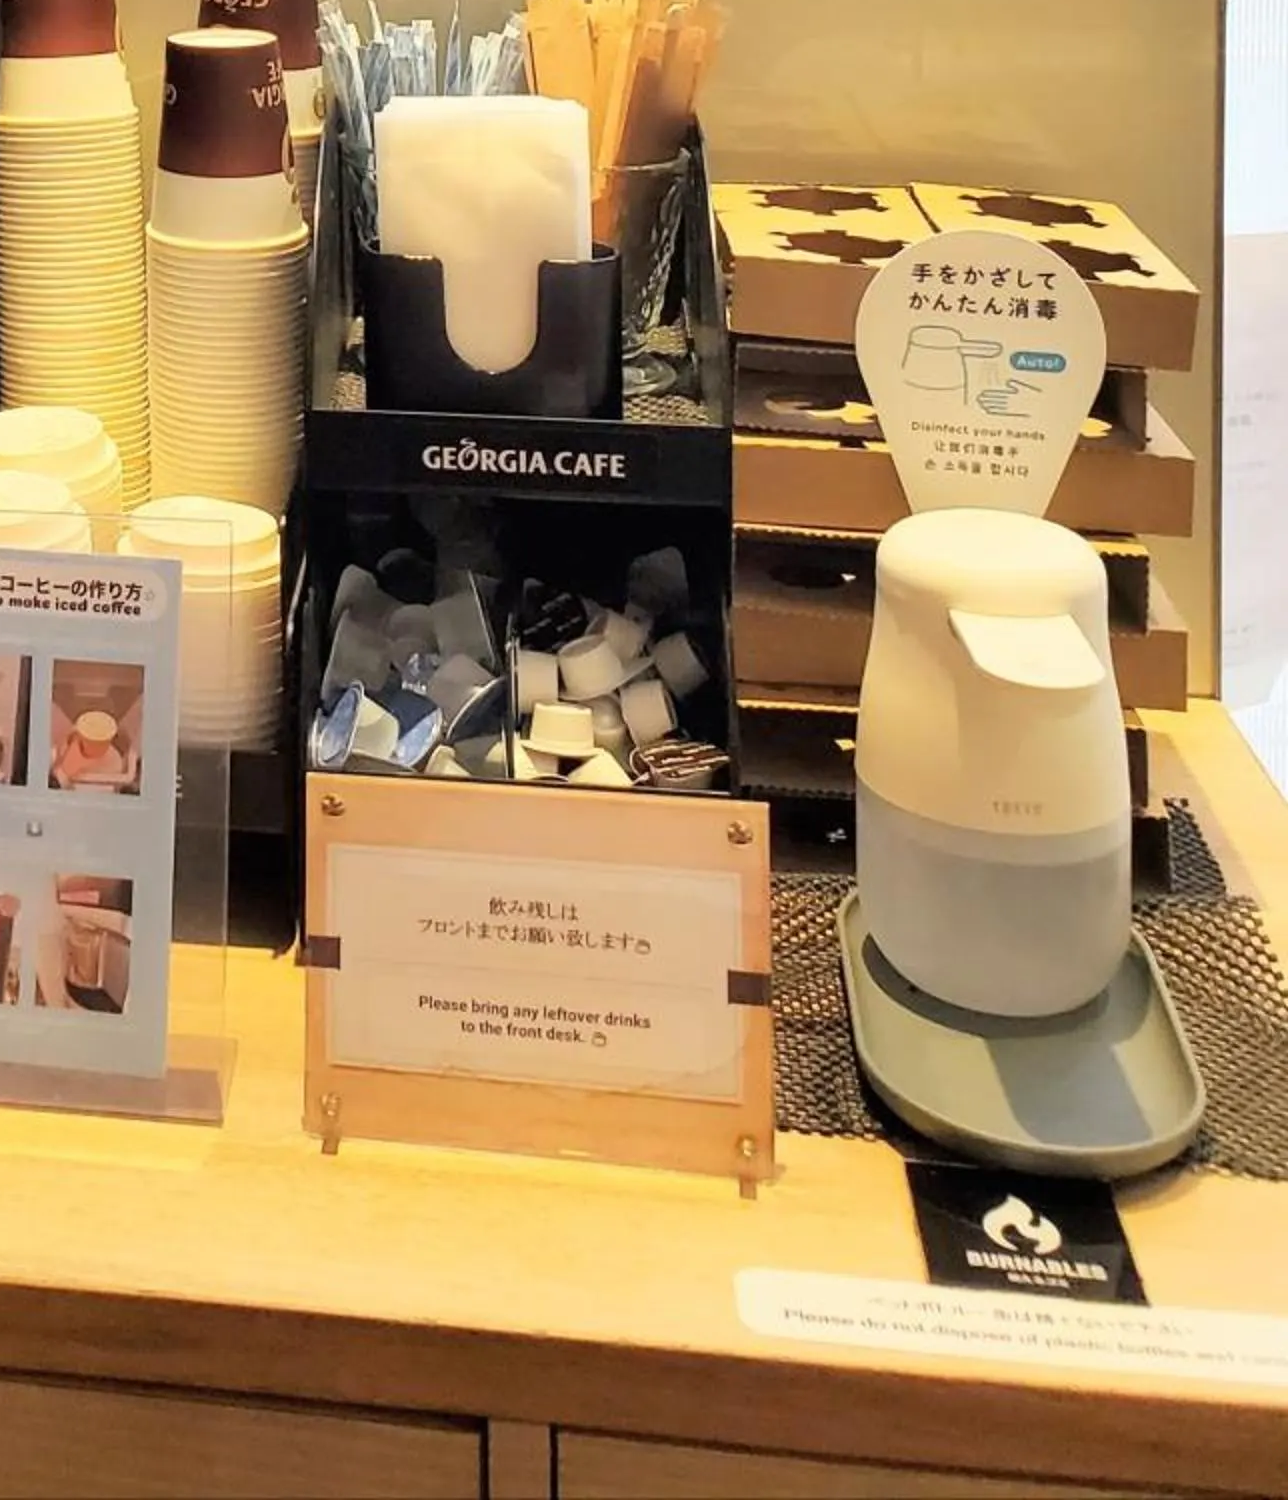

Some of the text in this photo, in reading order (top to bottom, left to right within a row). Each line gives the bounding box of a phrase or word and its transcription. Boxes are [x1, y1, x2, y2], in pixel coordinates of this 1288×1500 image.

[911, 263, 1057, 291] 手をかざして
[909, 292, 1058, 320] かんたん消毒
[911, 421, 1045, 441] Disinfect your hands
[422, 437, 627, 479] GEORGIA CAFE
[9, 596, 51, 610] make
[55, 597, 88, 612] iced
[92, 601, 142, 616] coffee
[488, 896, 579, 922] 飲み残しは
[417, 918, 635, 952] フロントまでお願い致します
[418, 995, 651, 1029] Please bring any leftover drinks
[462, 1021, 476, 1033] to
[479, 1021, 503, 1036] the
[506, 1023, 542, 1040] front
